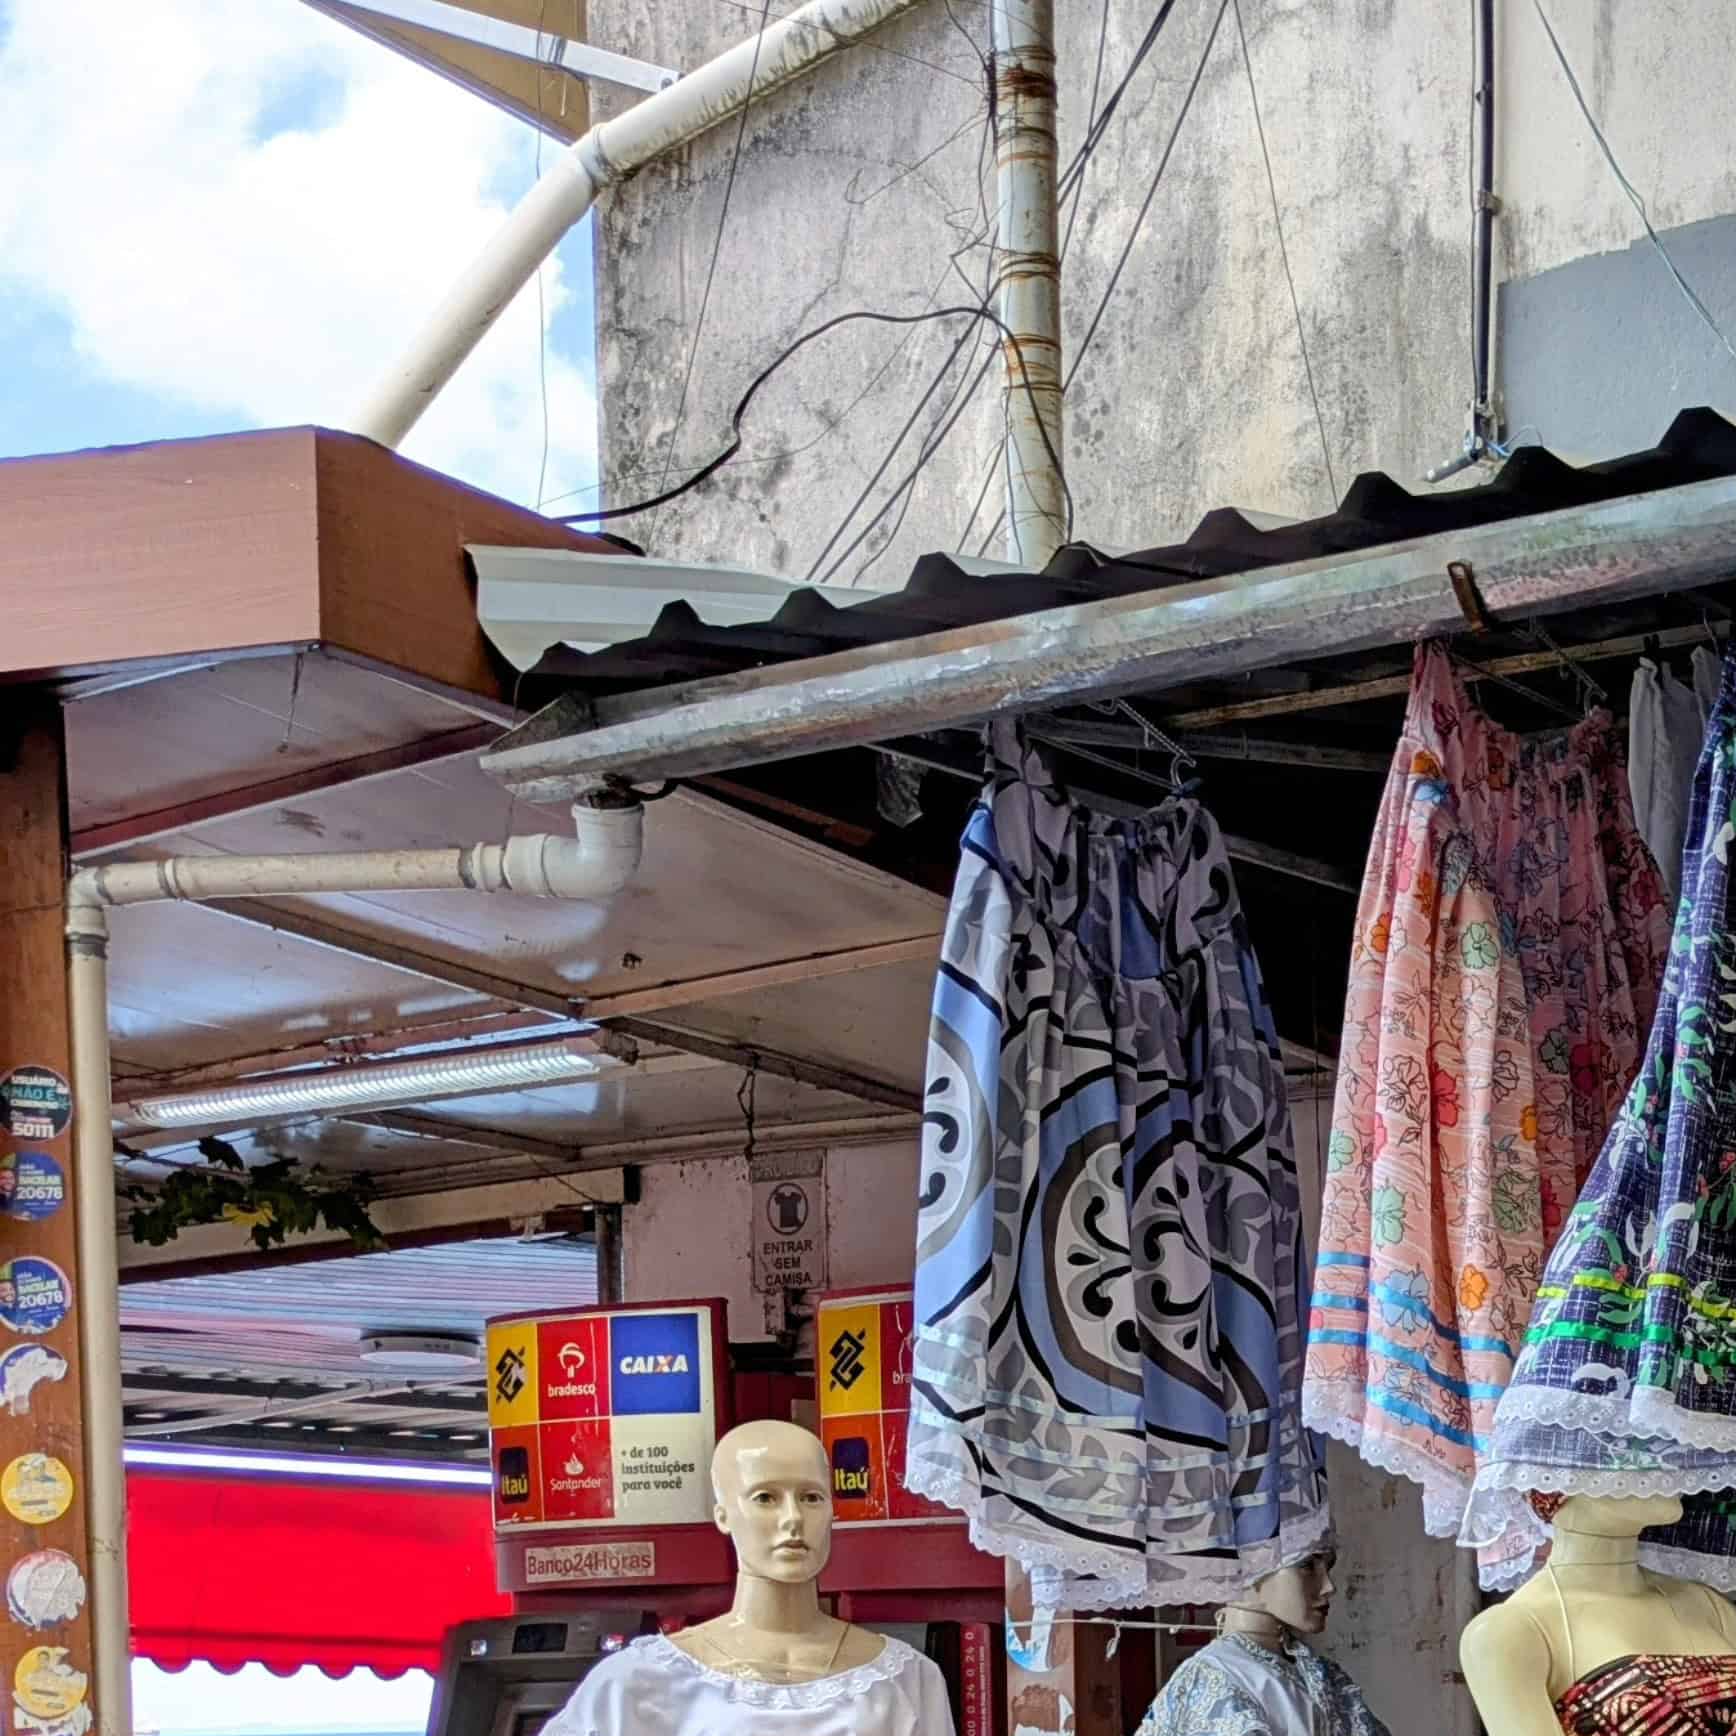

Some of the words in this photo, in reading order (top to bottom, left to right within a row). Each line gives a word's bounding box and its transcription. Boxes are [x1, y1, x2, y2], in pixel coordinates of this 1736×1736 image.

[16, 1186, 64, 1201] 20678
[763, 1239, 813, 1255] ENTRAR
[774, 1256, 801, 1270] SEM
[765, 1272, 812, 1287] CAMISA
[18, 1290, 65, 1310] 20678
[619, 1354, 689, 1375] CAIXA
[547, 1382, 596, 1397] bradesco
[630, 1446, 645, 1458] de
[647, 1445, 669, 1458] 100
[549, 1476, 602, 1491] Santander
[622, 1480, 652, 1494] para
[653, 1476, 683, 1490] você
[527, 1551, 652, 1576] Banco24Horas
